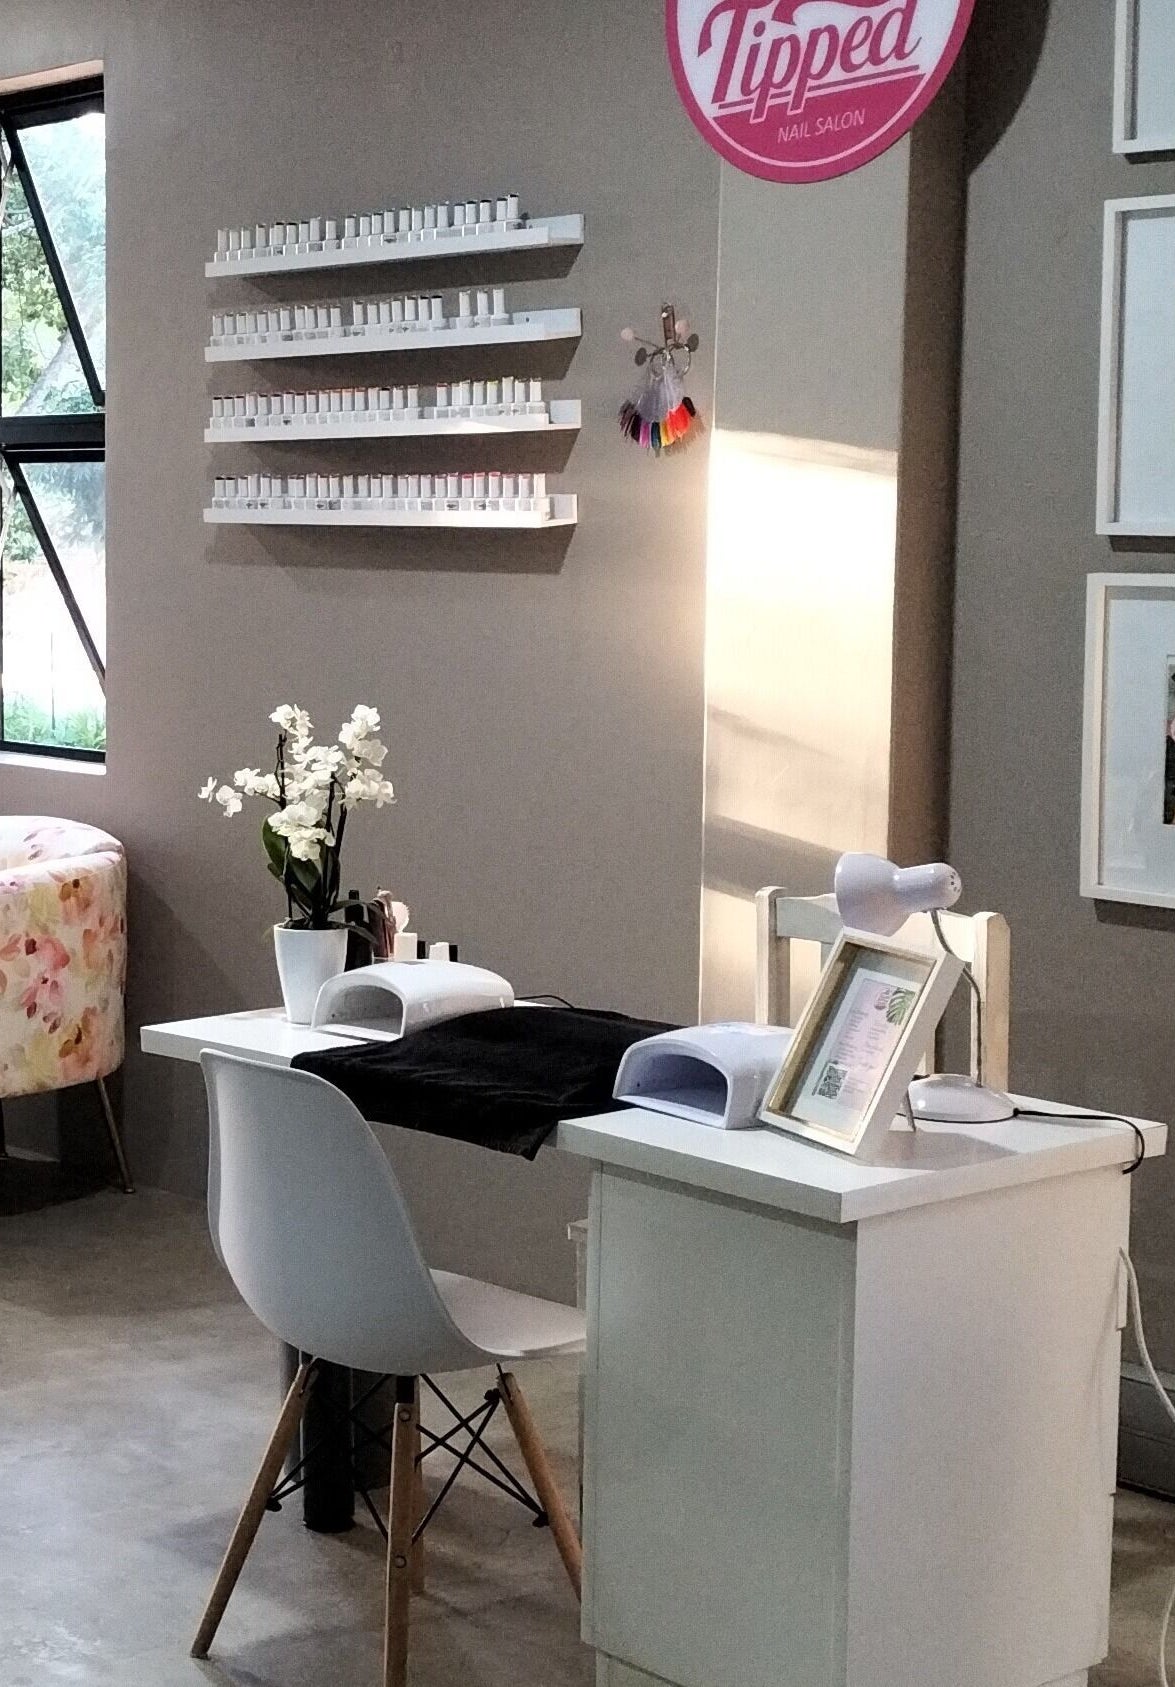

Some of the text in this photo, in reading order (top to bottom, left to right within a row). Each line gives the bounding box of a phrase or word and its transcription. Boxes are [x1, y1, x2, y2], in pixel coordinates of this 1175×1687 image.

[697, 0, 922, 123] Tipped
[777, 109, 866, 144] NAIL SALON
